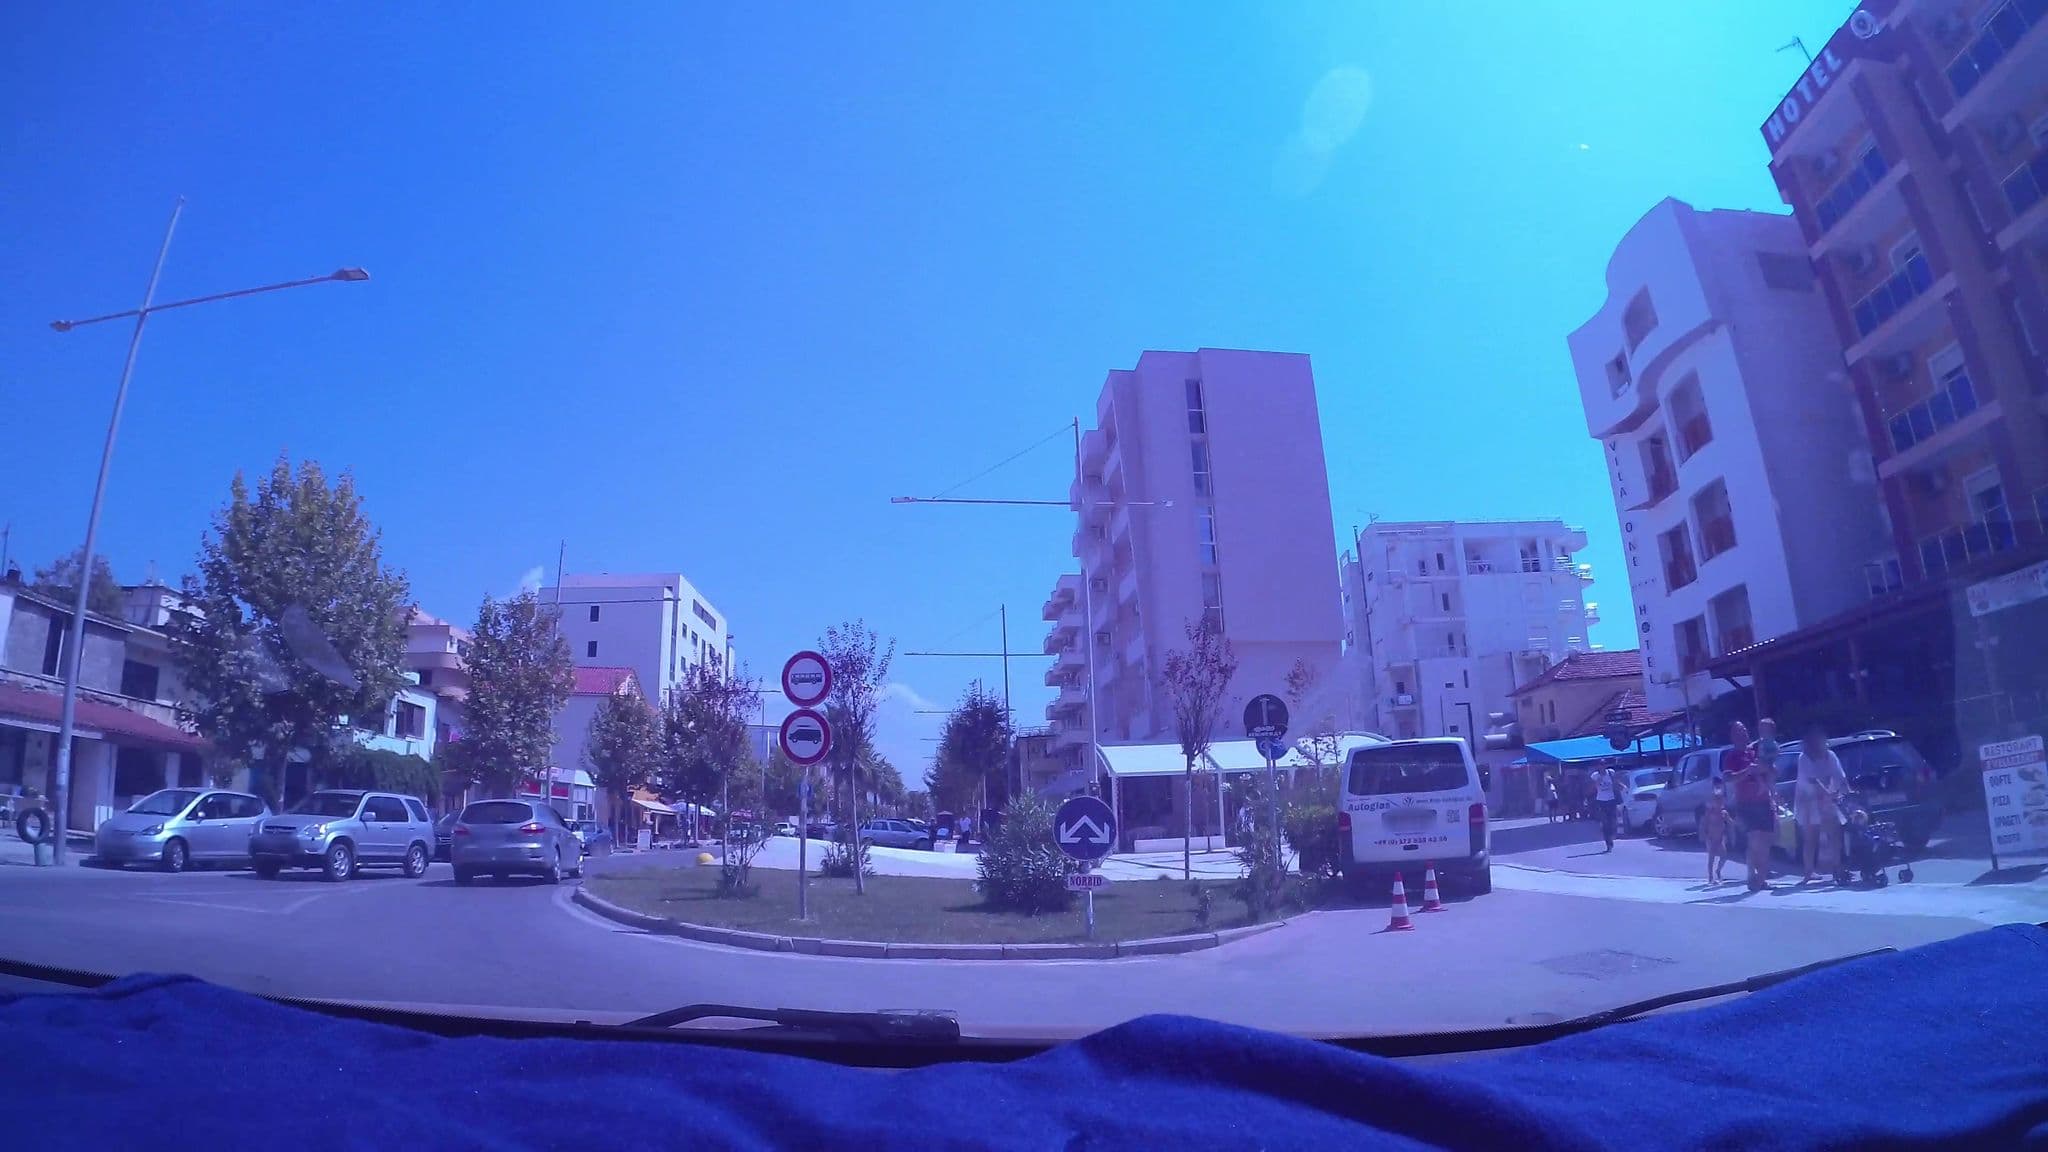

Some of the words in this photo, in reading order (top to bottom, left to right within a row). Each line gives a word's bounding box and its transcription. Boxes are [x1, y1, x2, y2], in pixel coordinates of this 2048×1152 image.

[1767, 49, 1842, 142] HOTEL
[1609, 440, 1628, 498] VILA
[1625, 522, 1640, 567] ONE
[1639, 604, 1657, 684] HOTEL
